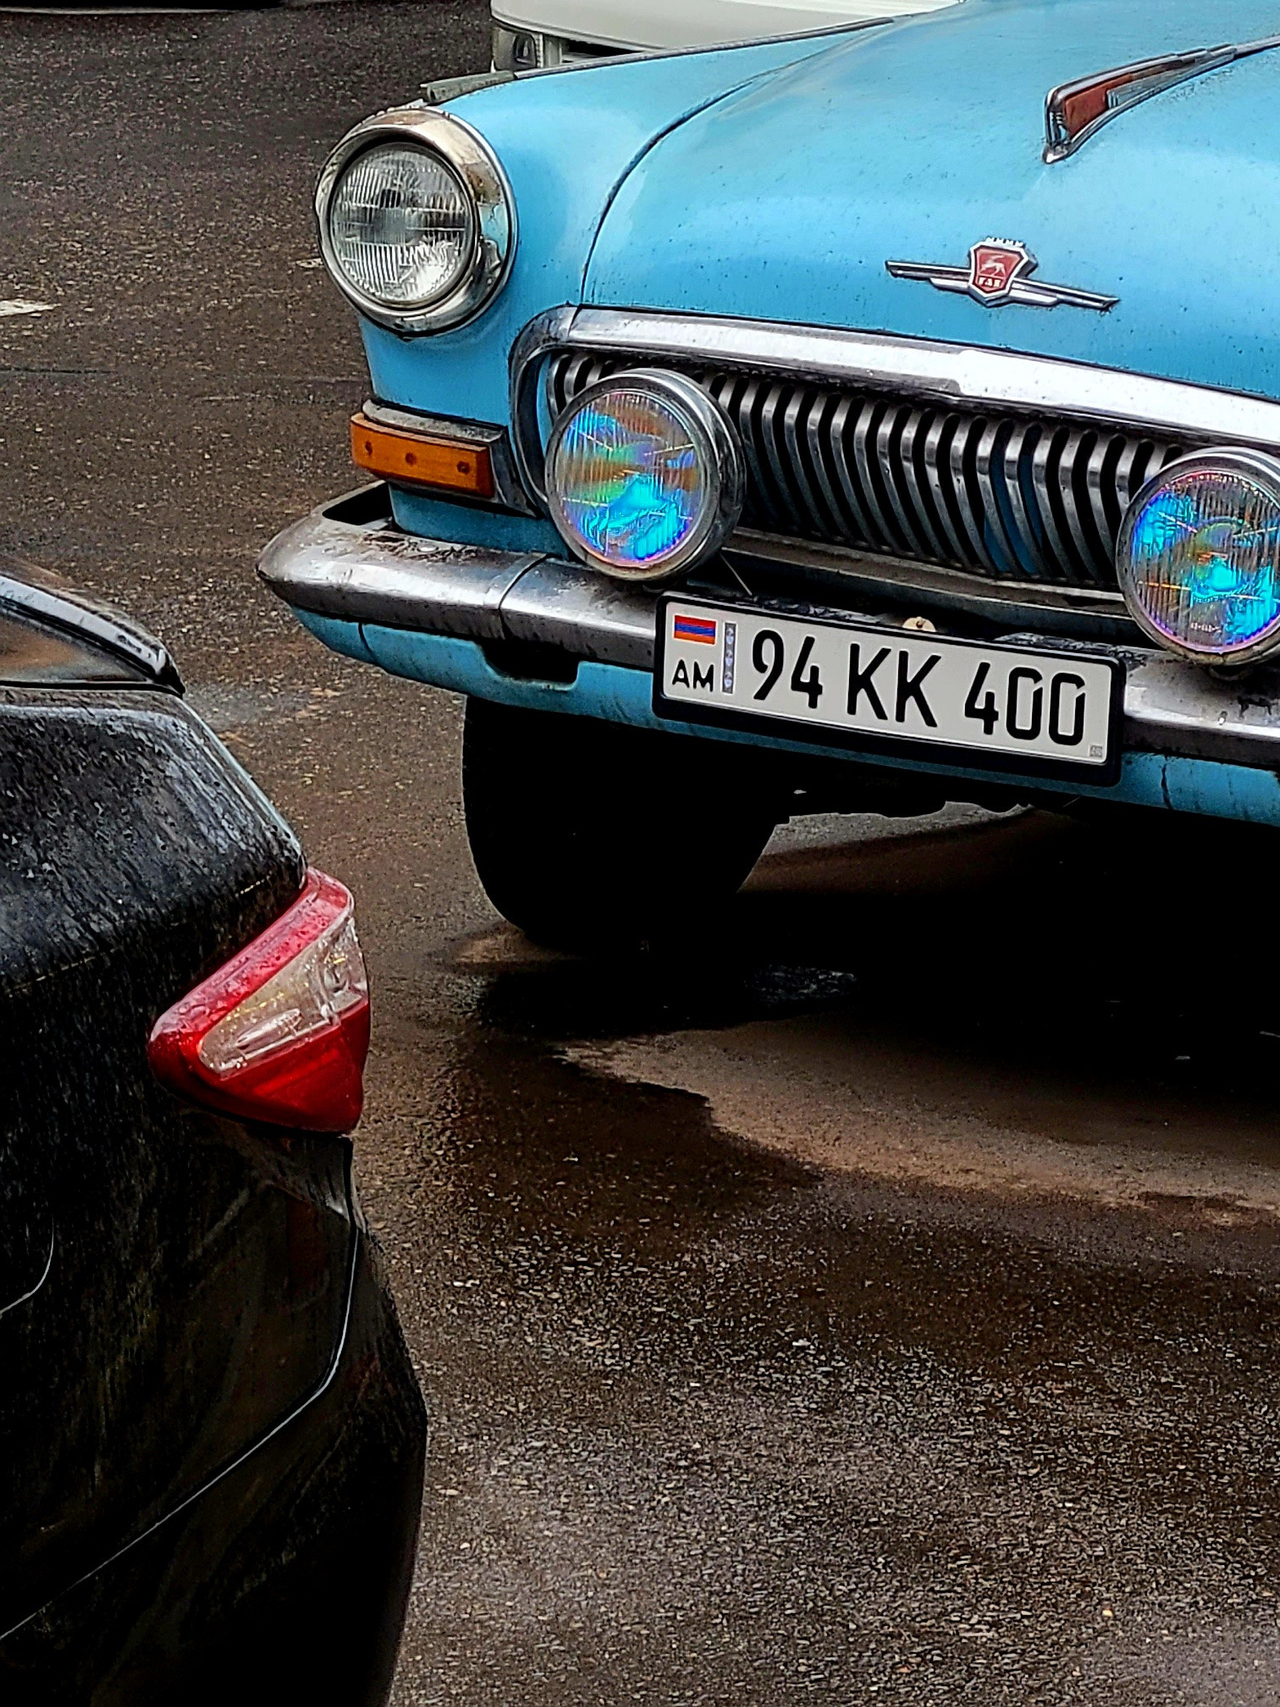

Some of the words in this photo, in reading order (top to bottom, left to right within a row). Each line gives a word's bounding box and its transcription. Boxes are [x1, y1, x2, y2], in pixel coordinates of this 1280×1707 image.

[670, 658, 715, 694] AM
[751, 628, 824, 710] 94
[845, 641, 943, 729] KK
[964, 661, 1087, 747] 400
